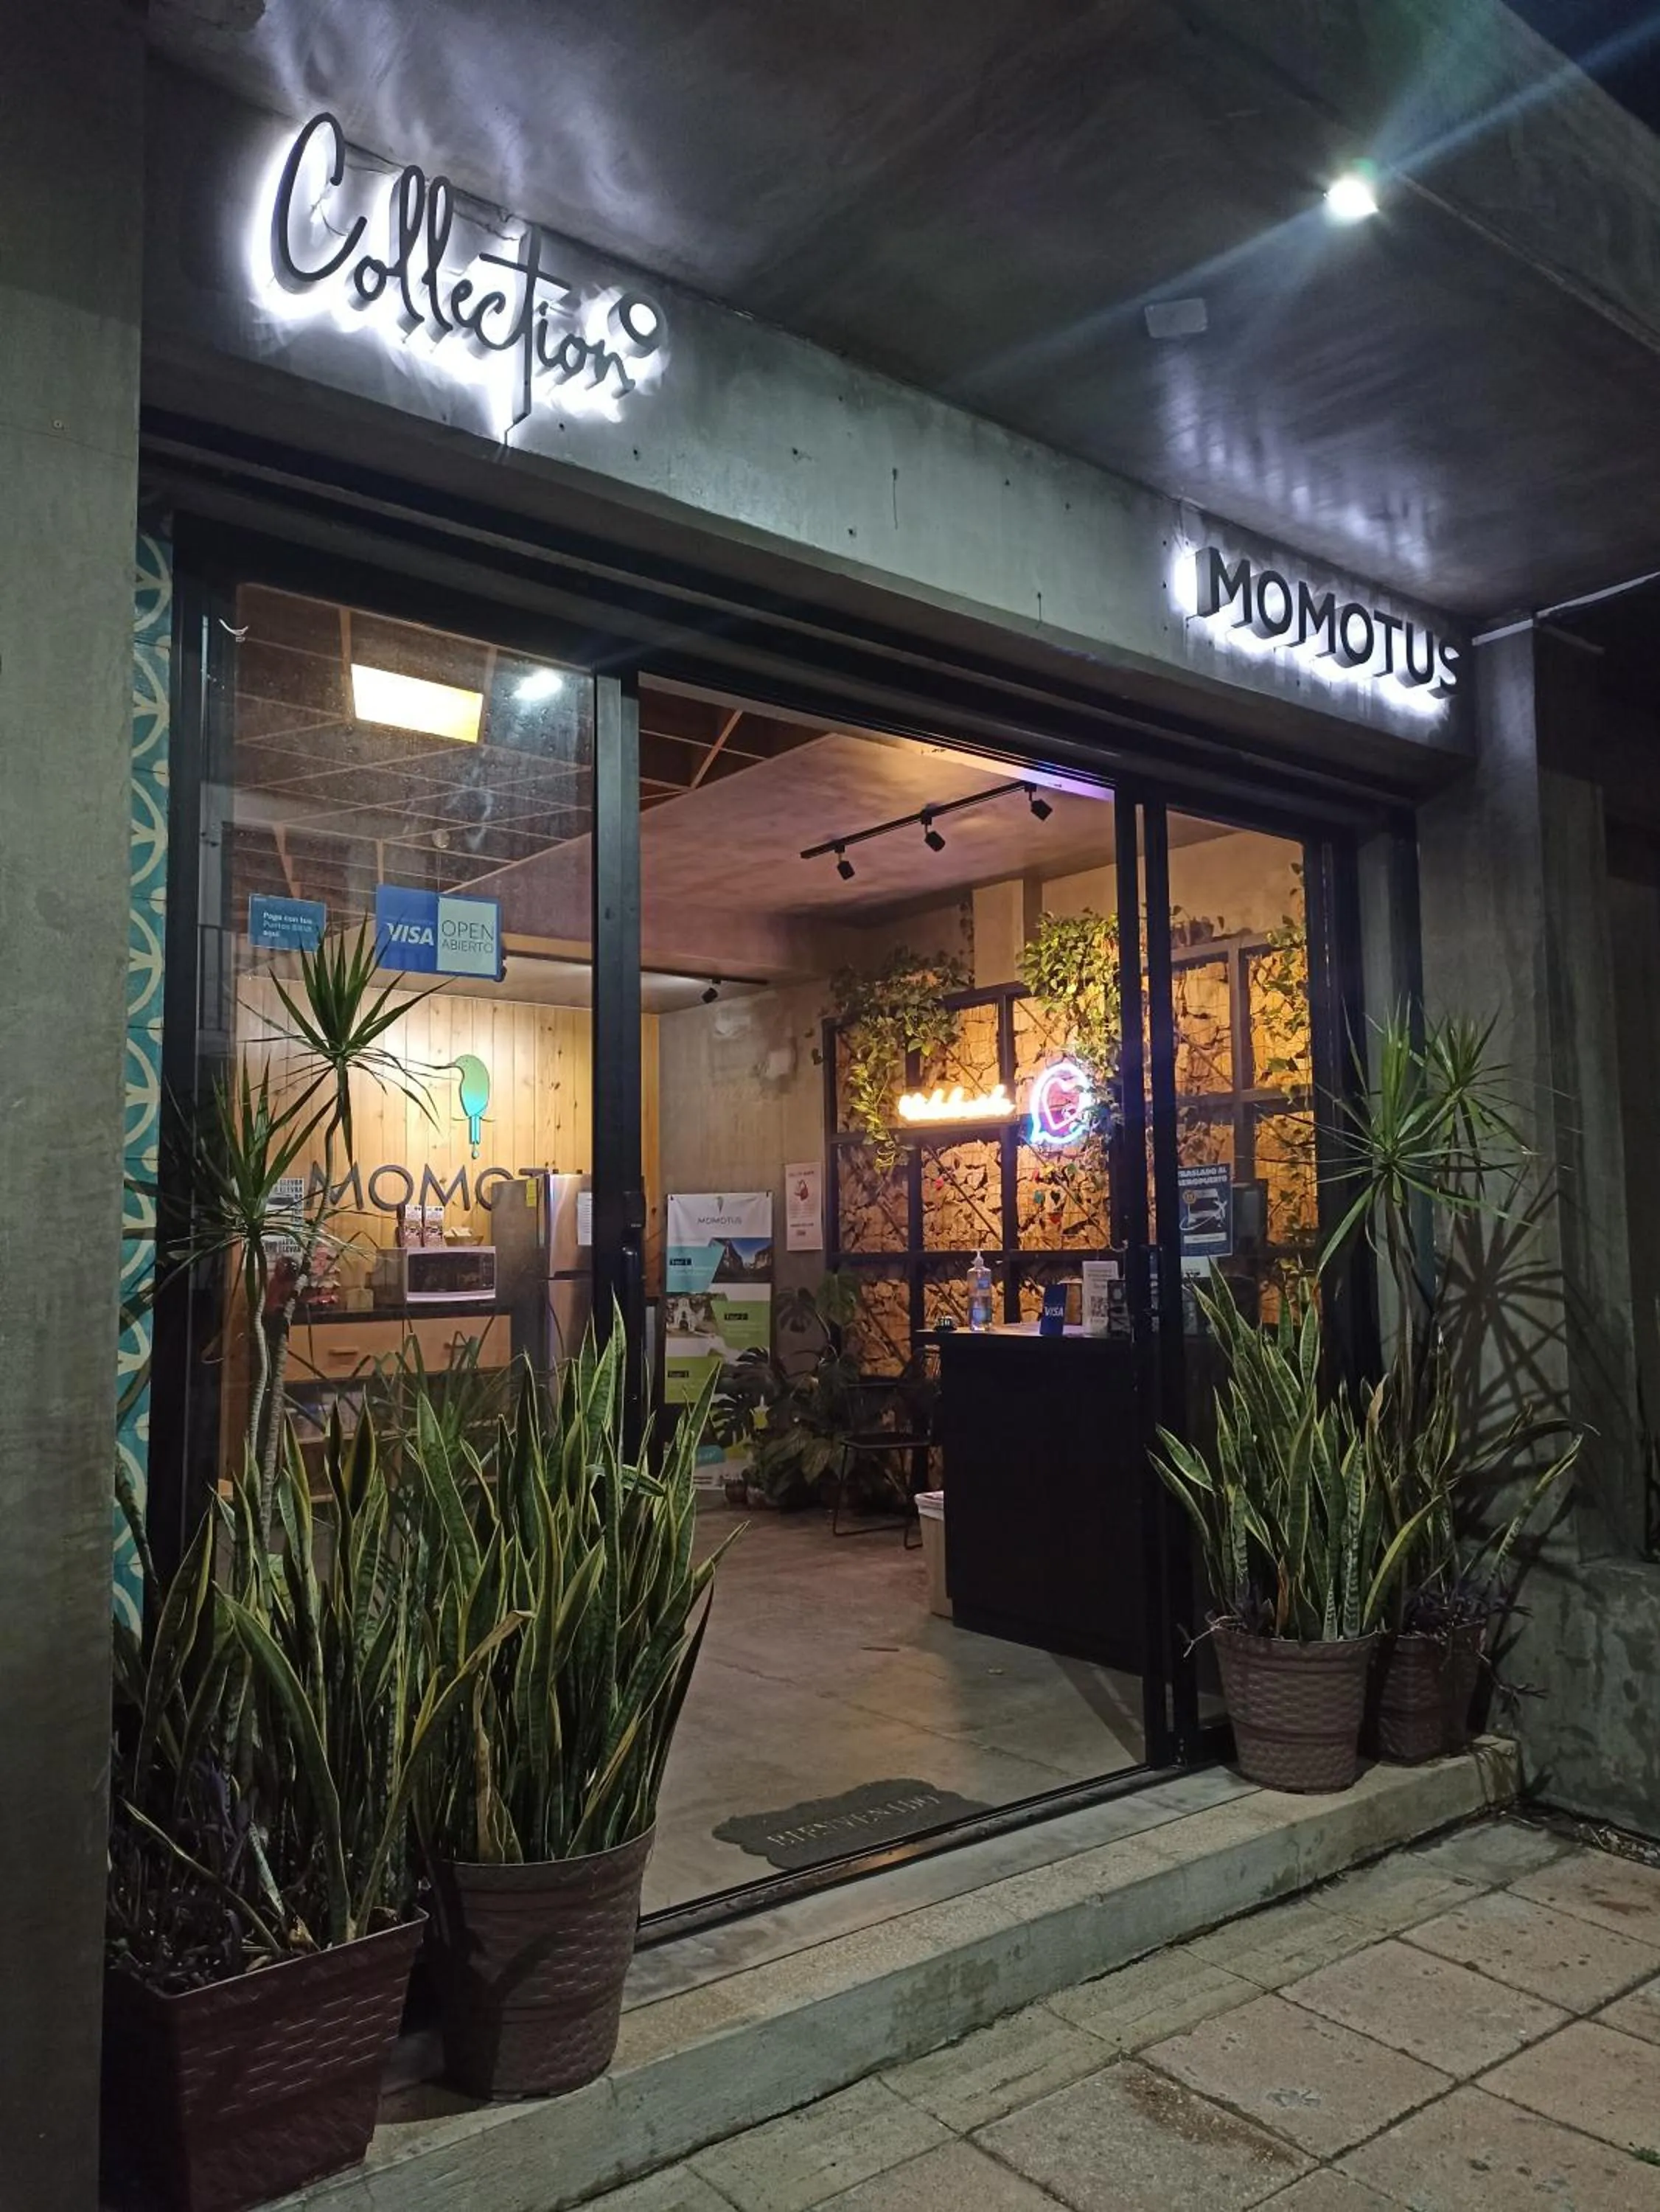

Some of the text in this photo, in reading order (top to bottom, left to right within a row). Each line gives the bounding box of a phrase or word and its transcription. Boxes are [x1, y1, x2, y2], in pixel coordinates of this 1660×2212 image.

[1196, 546, 1461, 698] MOMOTUS
[385, 922, 434, 947] VISA
[442, 919, 494, 941] OPEN
[442, 939, 494, 953] ABIERTO
[697, 1216, 742, 1225] MOMOTUS
[1044, 1306, 1064, 1316] VISA
